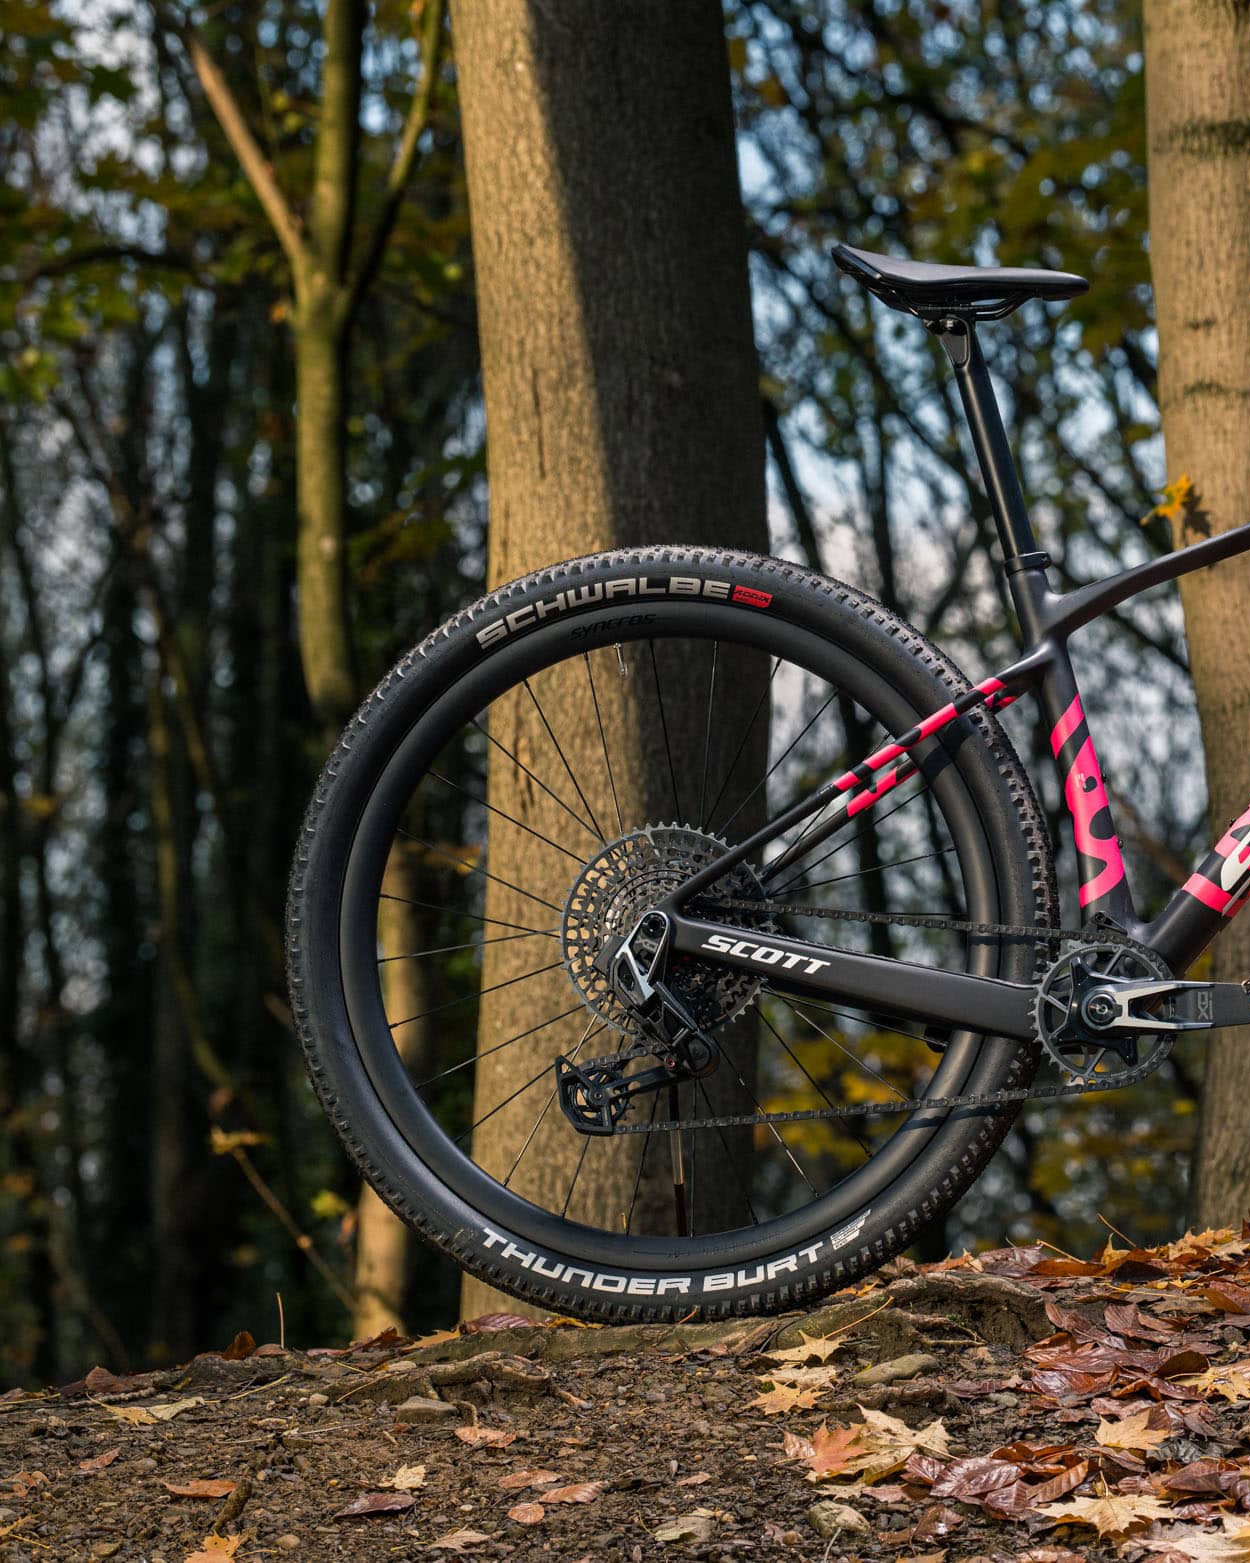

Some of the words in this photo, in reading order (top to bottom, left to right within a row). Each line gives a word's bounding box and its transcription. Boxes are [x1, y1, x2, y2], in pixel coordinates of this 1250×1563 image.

[475, 576, 731, 650] SCHWALBE
[701, 934, 831, 975] SCOTT
[482, 1227, 691, 1296] THUNDER
[702, 1242, 823, 1292] BURT
